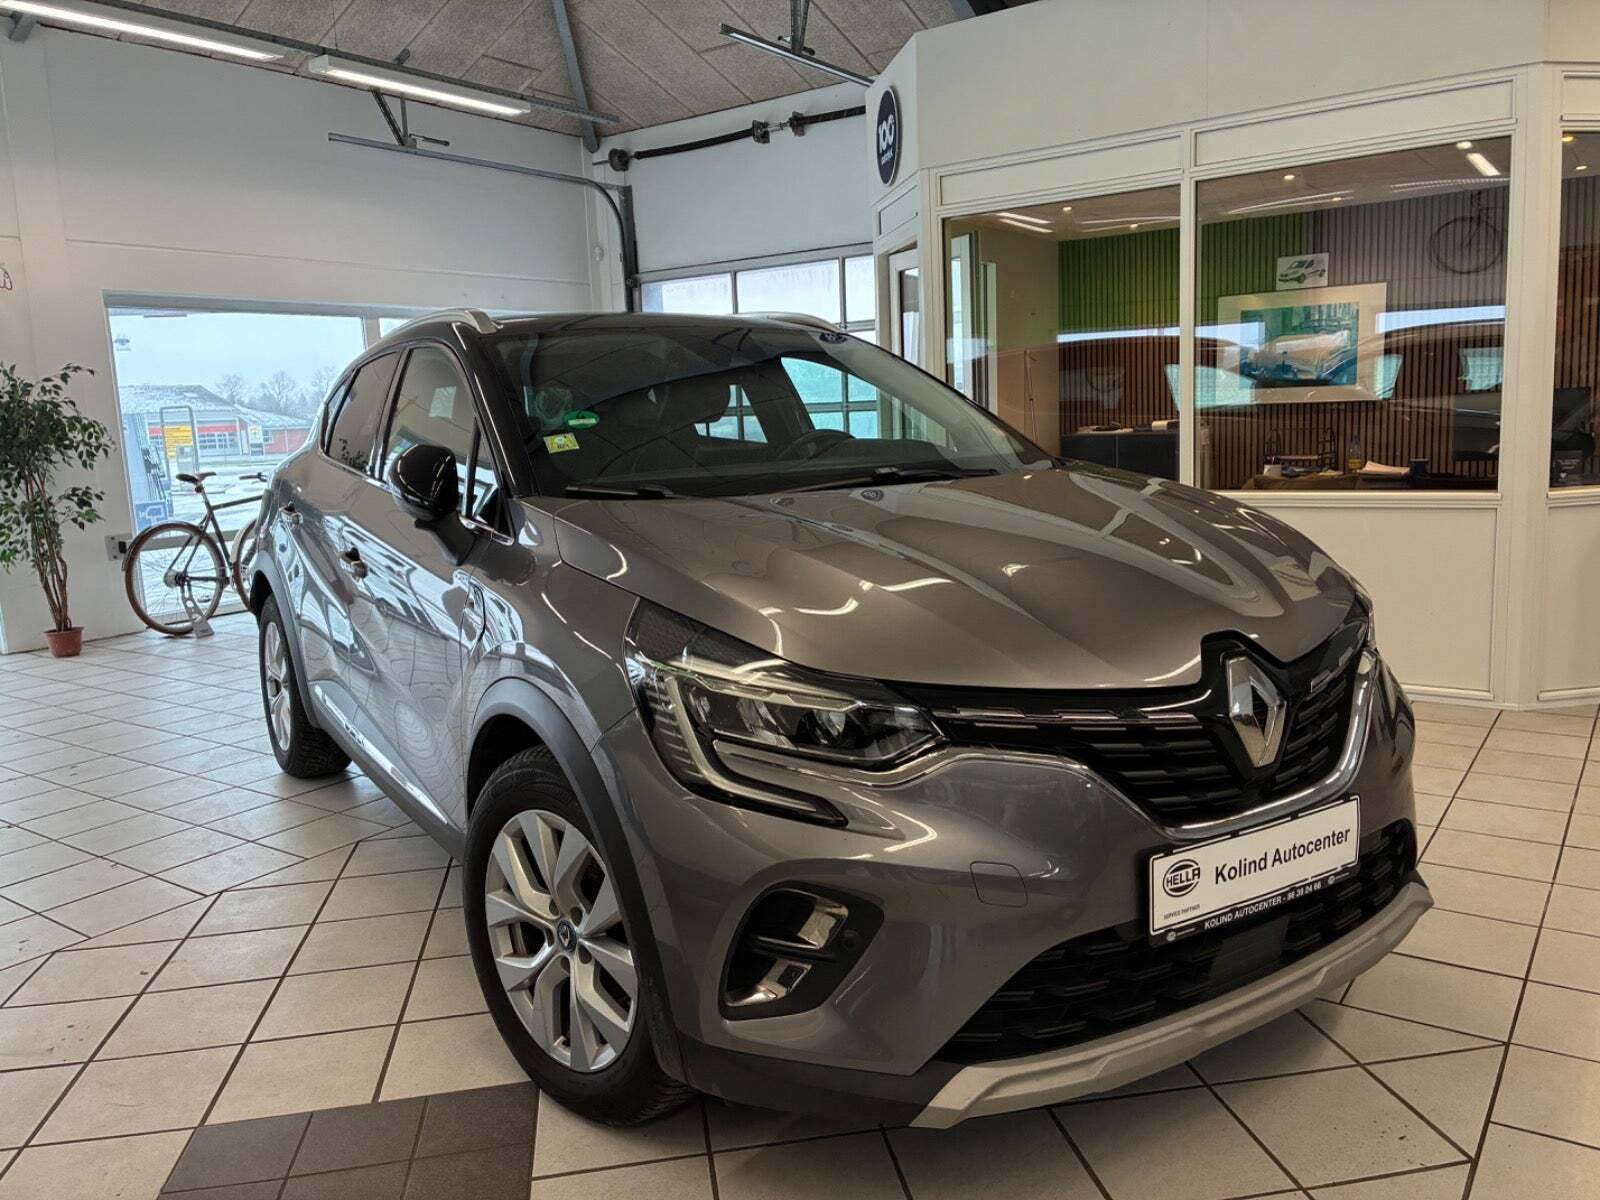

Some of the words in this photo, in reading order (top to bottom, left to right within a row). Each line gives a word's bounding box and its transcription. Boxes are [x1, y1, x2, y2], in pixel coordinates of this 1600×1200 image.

[1214, 852, 1268, 885] Kolind
[1271, 828, 1351, 868] Autocenter
[1166, 867, 1200, 887] HELLA
[1204, 913, 1233, 930] KOLIND
[1234, 895, 1282, 920] AUTOCENTER
